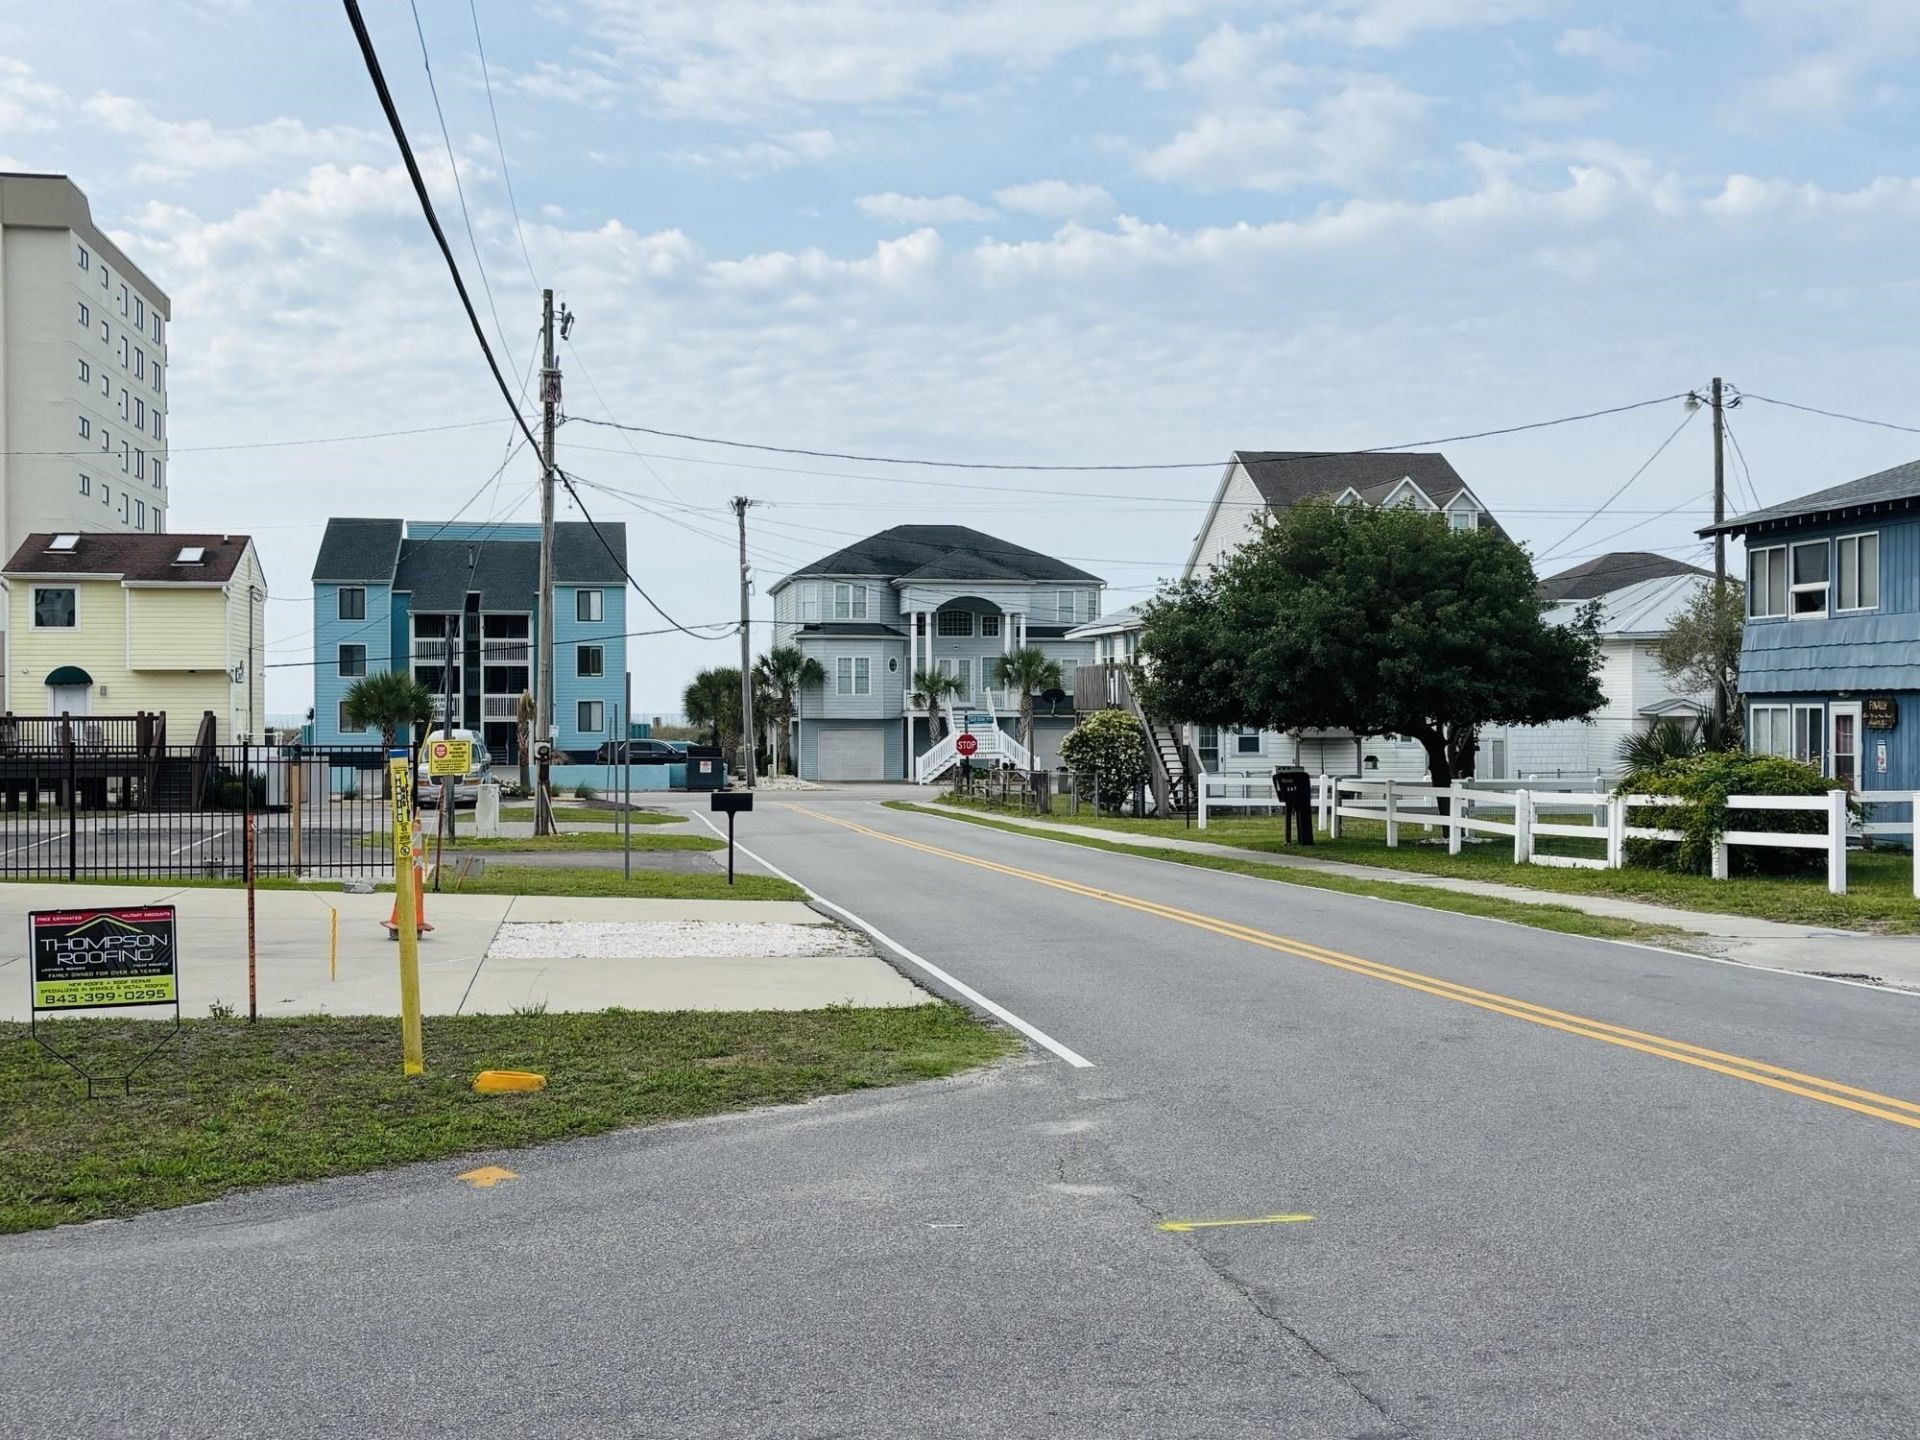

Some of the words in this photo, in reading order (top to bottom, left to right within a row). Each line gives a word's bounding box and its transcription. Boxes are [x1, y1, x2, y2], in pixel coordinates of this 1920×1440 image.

[958, 741, 976, 750] STOP
[40, 934, 168, 952] THOMPSON
[57, 948, 154, 966] ROOFING
[46, 990, 166, 1004] 843-399-0295
